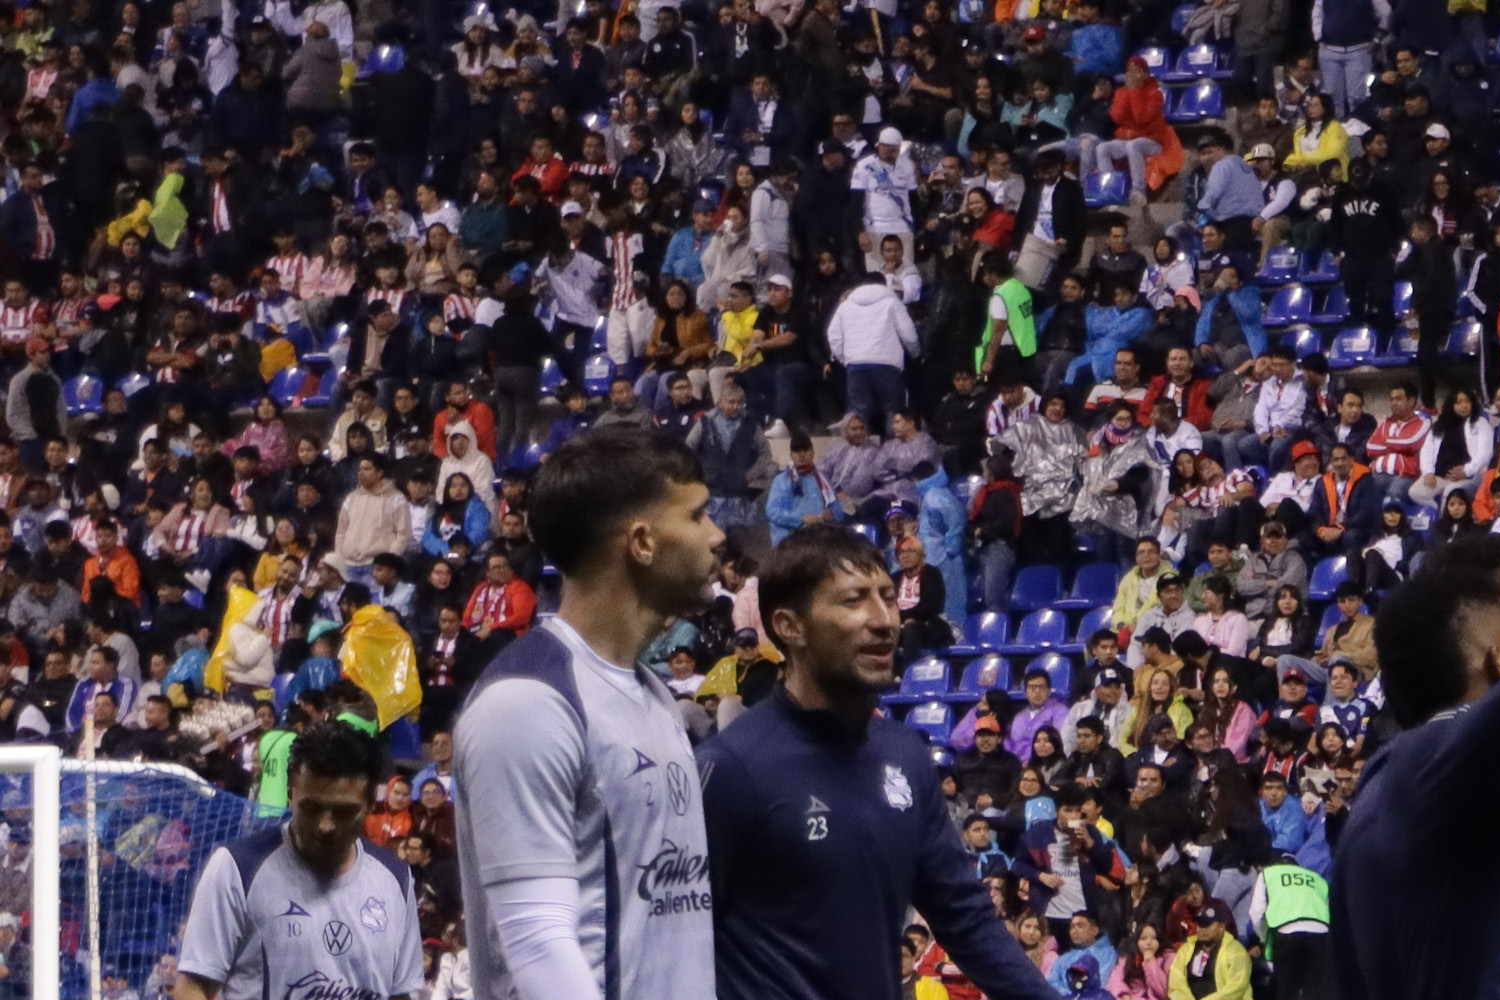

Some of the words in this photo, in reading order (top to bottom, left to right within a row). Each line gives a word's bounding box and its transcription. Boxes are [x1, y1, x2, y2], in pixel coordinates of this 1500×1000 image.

[1343, 199, 1380, 217] NIKE
[806, 816, 829, 841] 23
[1280, 872, 1316, 890] 052
